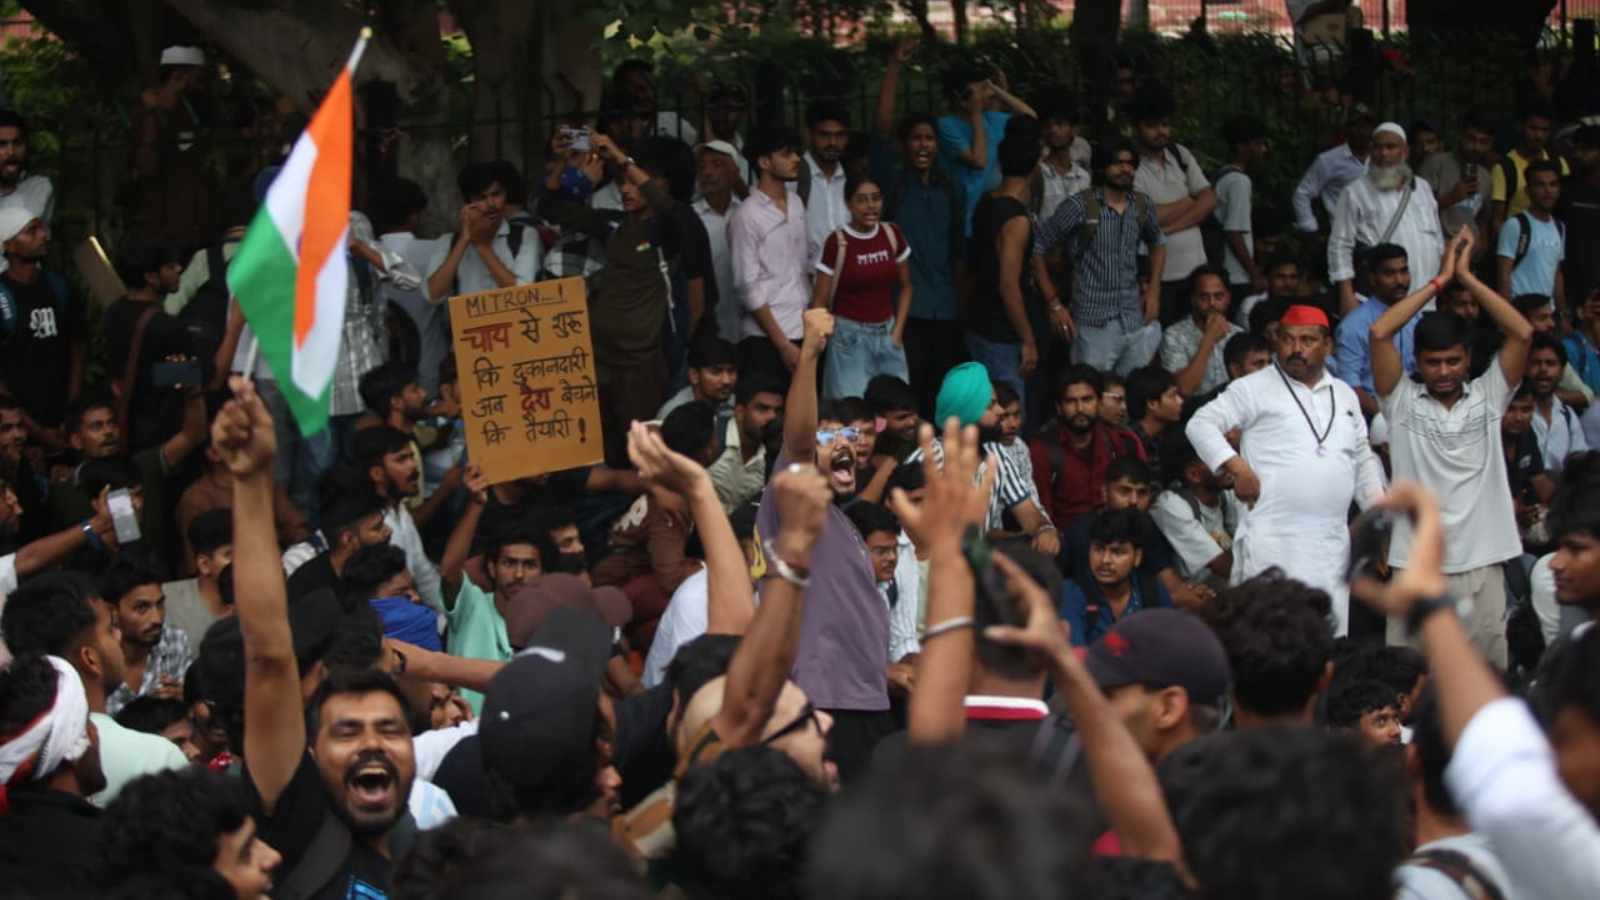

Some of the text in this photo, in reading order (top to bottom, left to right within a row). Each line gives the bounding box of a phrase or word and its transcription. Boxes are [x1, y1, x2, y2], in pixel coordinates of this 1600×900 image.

[460, 321, 512, 352] चाय
[518, 307, 541, 344] से
[473, 356, 504, 392] कि
[480, 420, 512, 446] कि
